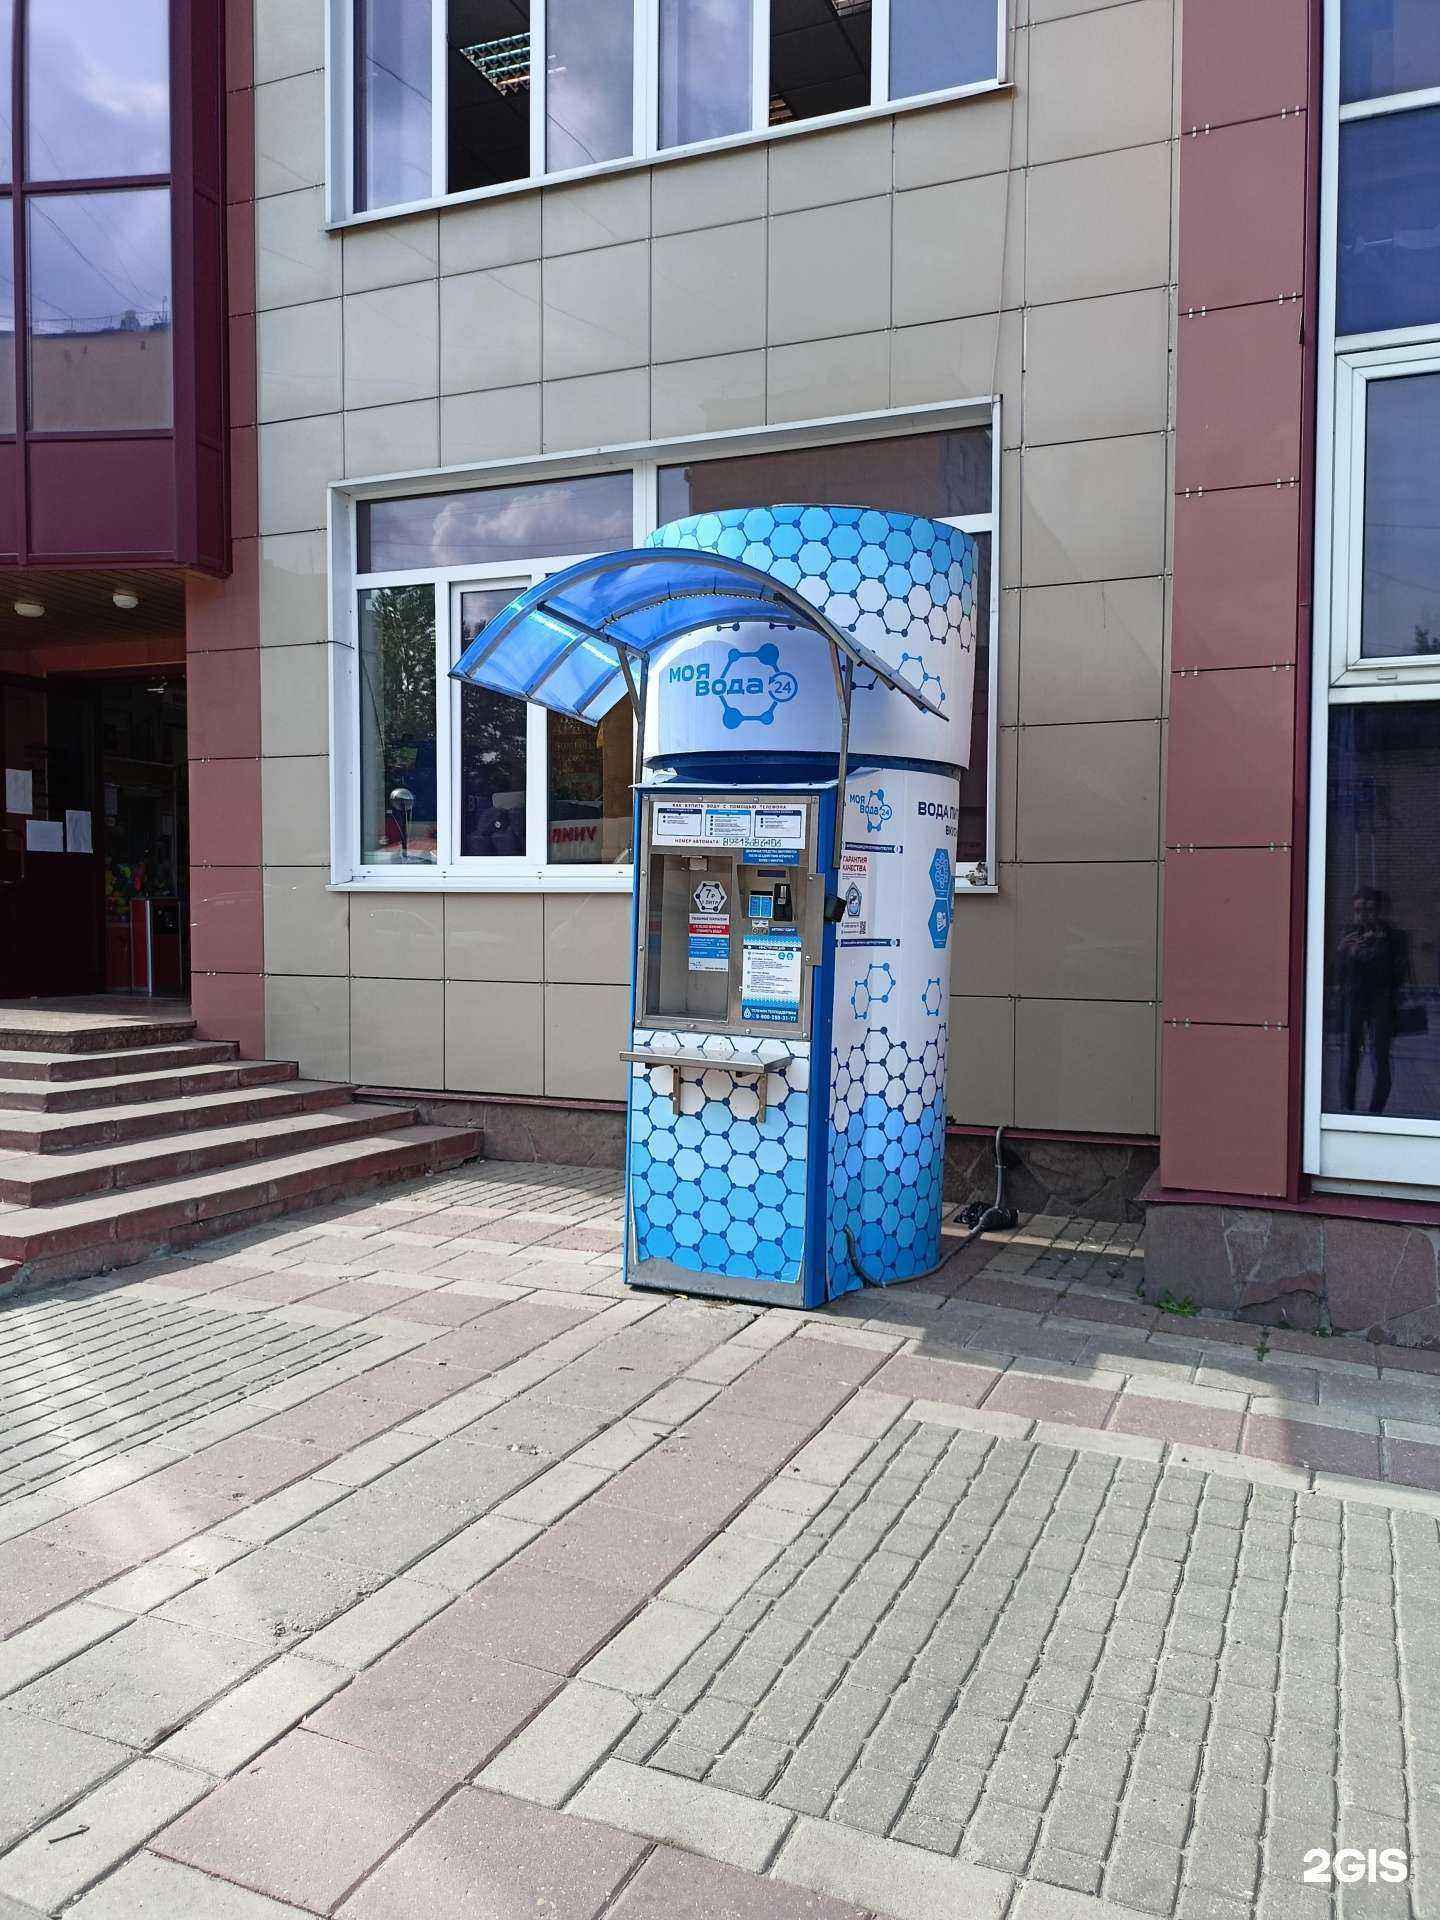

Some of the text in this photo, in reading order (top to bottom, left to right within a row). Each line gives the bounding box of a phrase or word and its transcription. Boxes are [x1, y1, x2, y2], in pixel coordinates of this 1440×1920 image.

[774, 681, 792, 694] 24
[881, 808, 890, 816] 24
[918, 801, 949, 820] ВОДА
[842, 855, 868, 864] ГАРАНТИЯ
[842, 864, 867, 873] КАЧЕСТВА
